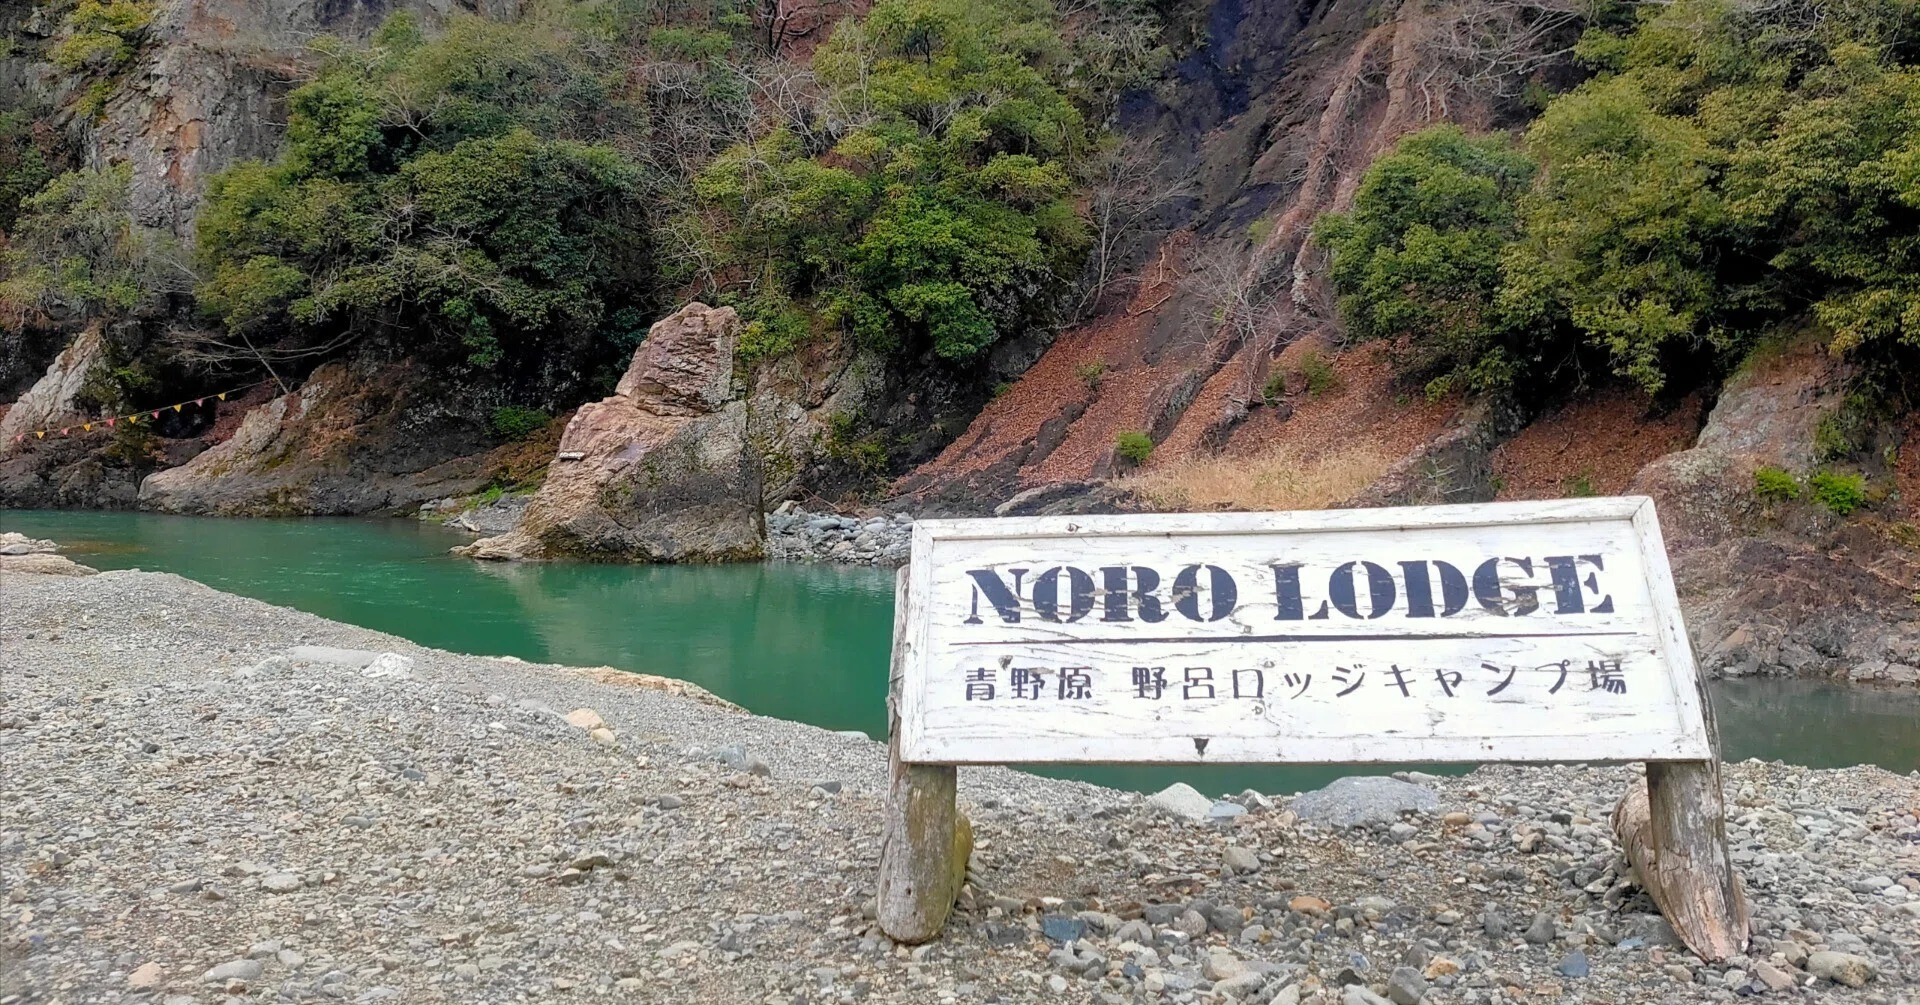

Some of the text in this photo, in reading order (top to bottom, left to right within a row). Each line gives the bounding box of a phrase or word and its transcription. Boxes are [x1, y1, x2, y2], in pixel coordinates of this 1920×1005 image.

[964, 555, 1615, 624] NORO LODGE
[965, 660, 1627, 701] 青野原 野呂ロッジキャンプ場
